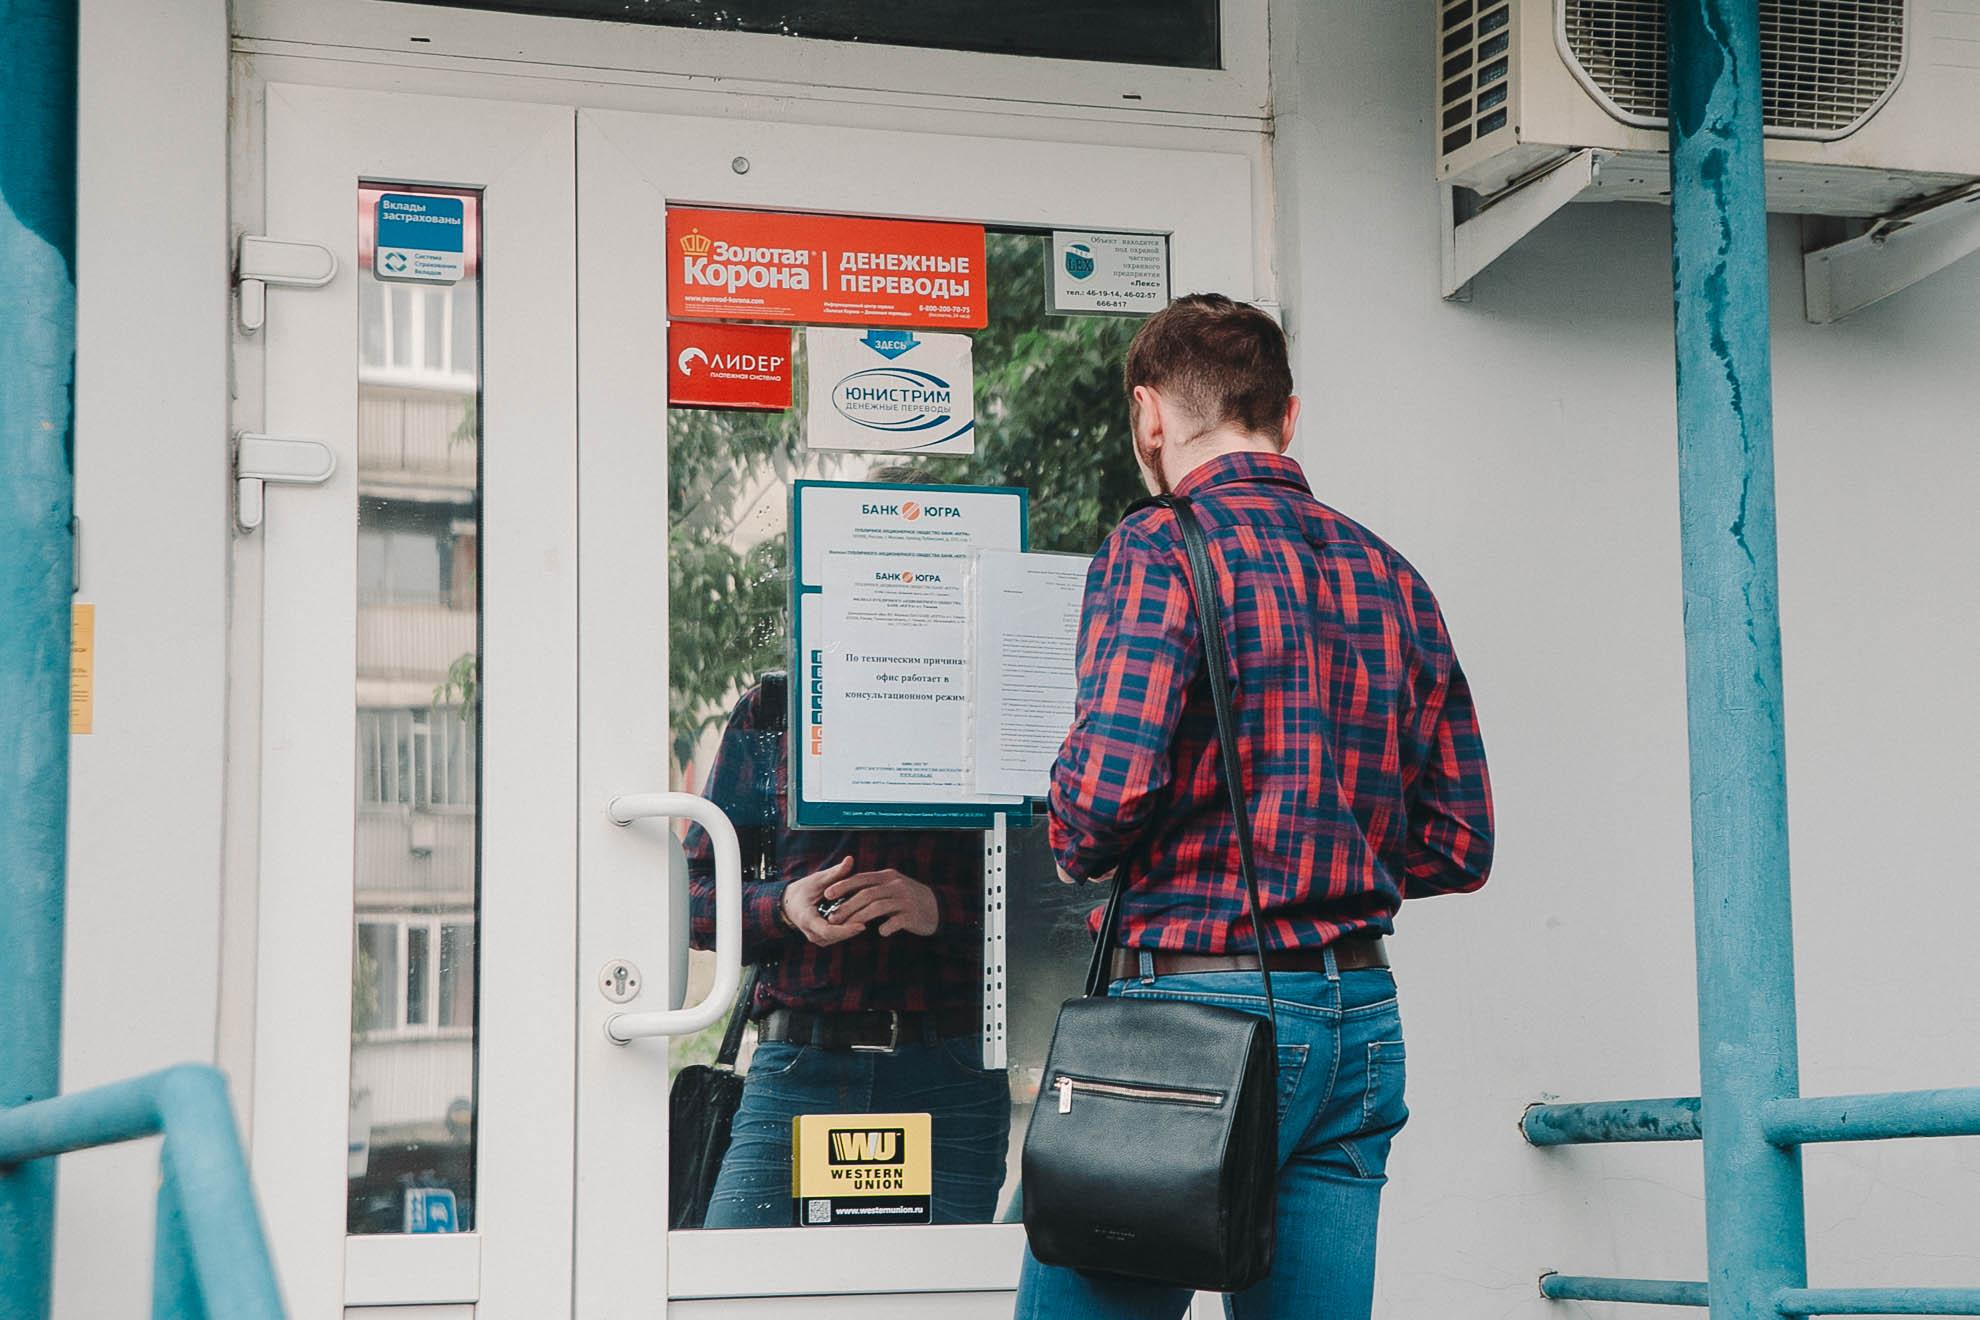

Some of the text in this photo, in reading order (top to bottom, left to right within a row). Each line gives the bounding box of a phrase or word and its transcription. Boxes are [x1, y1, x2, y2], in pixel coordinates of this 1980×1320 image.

[383, 200, 426, 212] Вклады
[383, 212, 461, 225] застрахованы
[713, 241, 809, 265] Золотая
[840, 251, 970, 273] ДЕНЕЖНЫЕ
[1068, 258, 1092, 272] LEX
[684, 256, 810, 294] Корона
[840, 274, 970, 299] ПЕРЕВОДЫ
[875, 340, 907, 350] ЗДЕСЬ
[710, 354, 782, 372] ЛИДЕР
[846, 387, 951, 403] ЮНИСТРИМ
[846, 402, 951, 413] ДЕНЕЖНЫЕ ПЕРЕВОДЫ
[862, 504, 961, 517] БАНК ЮГРА
[875, 572, 941, 582] БАНК ЮГРА
[845, 653, 859, 662] По
[862, 654, 921, 664] техническим
[876, 672, 898, 683] офис
[901, 673, 941, 684] работает
[845, 691, 965, 703] консультационном режим
[832, 1132, 896, 1161] WU
[831, 1168, 903, 1179] WESTERN
[854, 1180, 903, 1189] UNION
[835, 1205, 924, 1214] www.westernunion.ru
